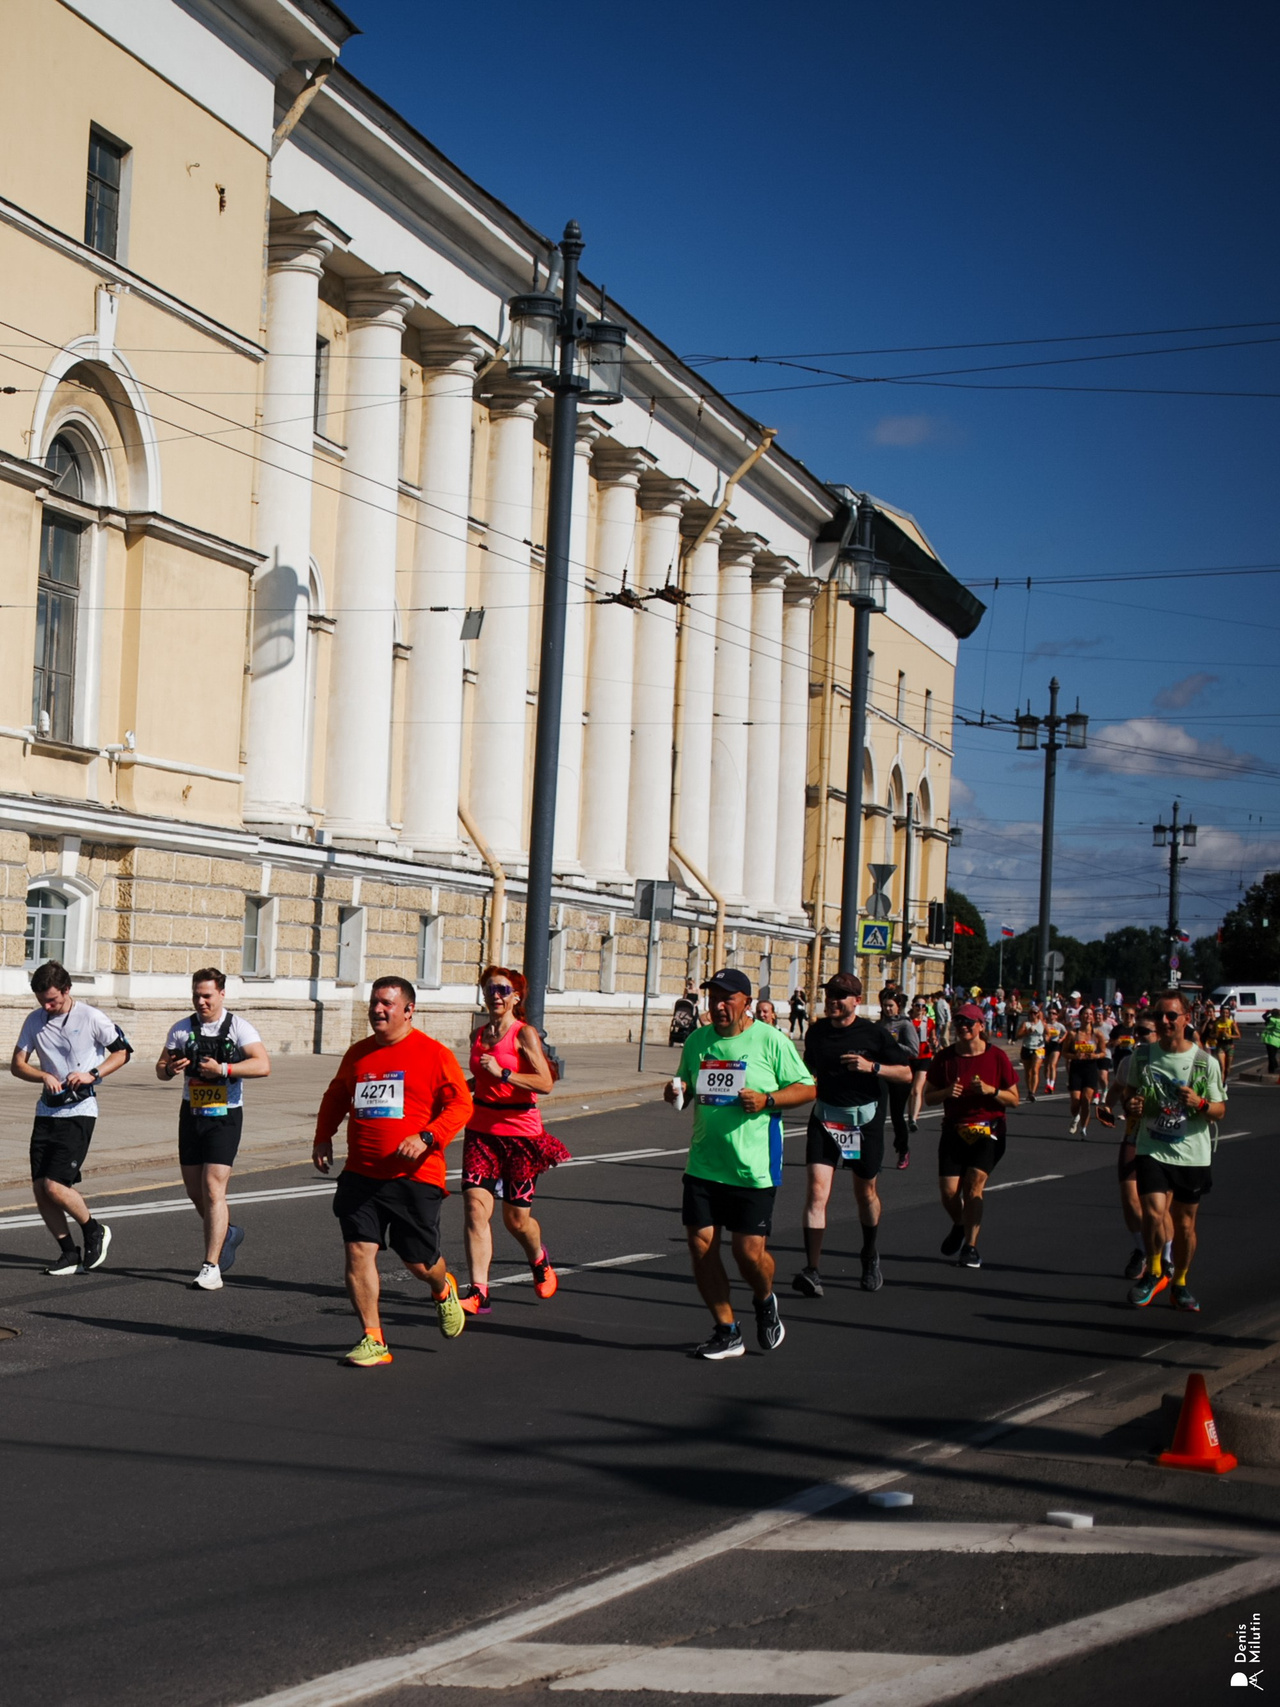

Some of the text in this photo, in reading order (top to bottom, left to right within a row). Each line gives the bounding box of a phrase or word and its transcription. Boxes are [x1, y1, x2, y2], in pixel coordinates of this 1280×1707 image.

[707, 1072, 734, 1087] 898
[192, 1088, 222, 1101] 5996
[360, 1084, 394, 1099] 4271
[829, 1132, 853, 1145] 301
